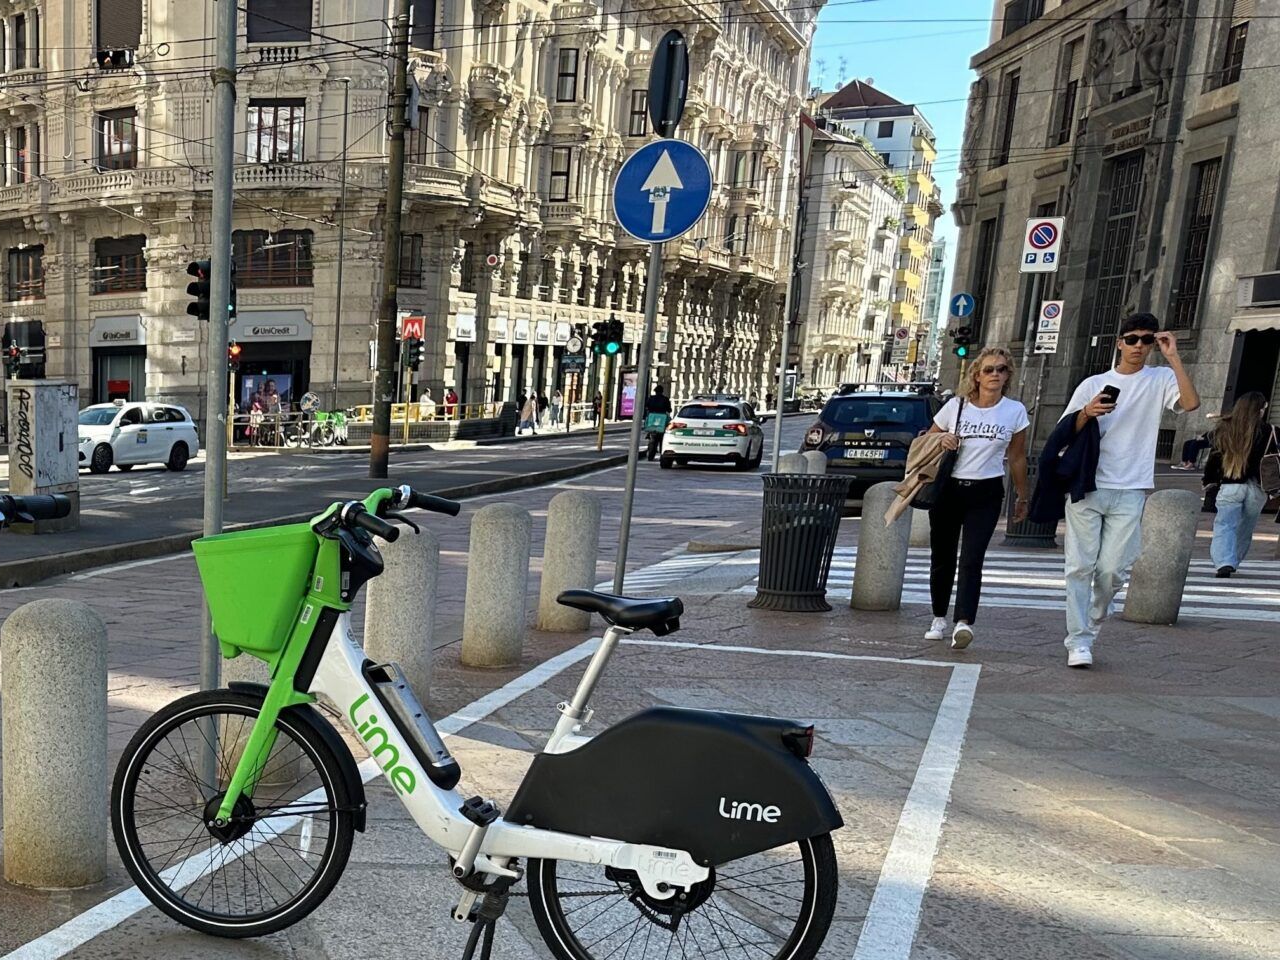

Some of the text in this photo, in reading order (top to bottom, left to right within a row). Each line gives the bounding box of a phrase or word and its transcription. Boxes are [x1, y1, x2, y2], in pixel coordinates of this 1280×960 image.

[261, 327, 290, 335] UniCredit
[349, 693, 416, 797] Lime
[719, 797, 781, 822] Lime
